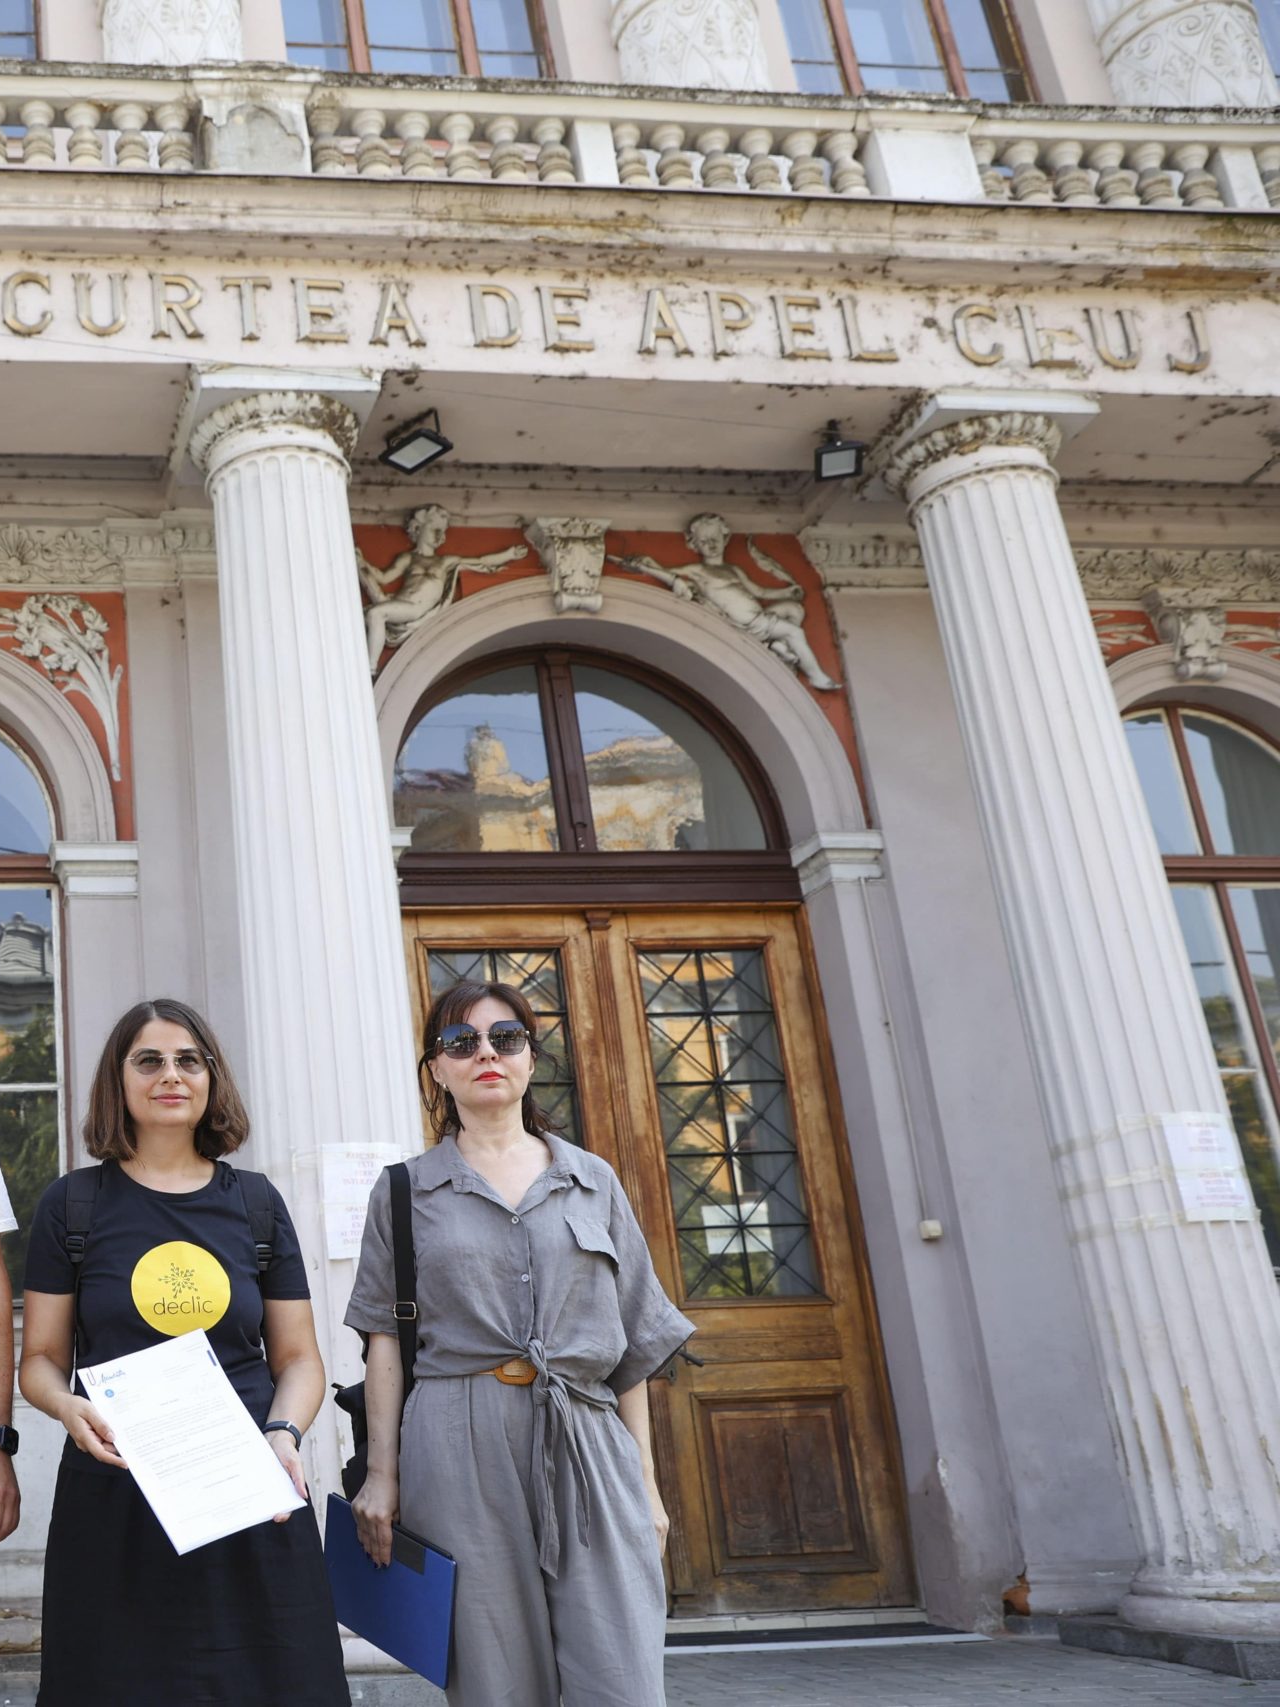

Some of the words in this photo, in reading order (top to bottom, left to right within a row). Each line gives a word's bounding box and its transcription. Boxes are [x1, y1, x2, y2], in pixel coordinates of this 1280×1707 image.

[1, 271, 426, 347] CURTEA
[466, 283, 595, 352] DE
[637, 289, 900, 364] APEL
[952, 304, 1213, 374] CLUJ
[153, 1295, 214, 1316] declic
